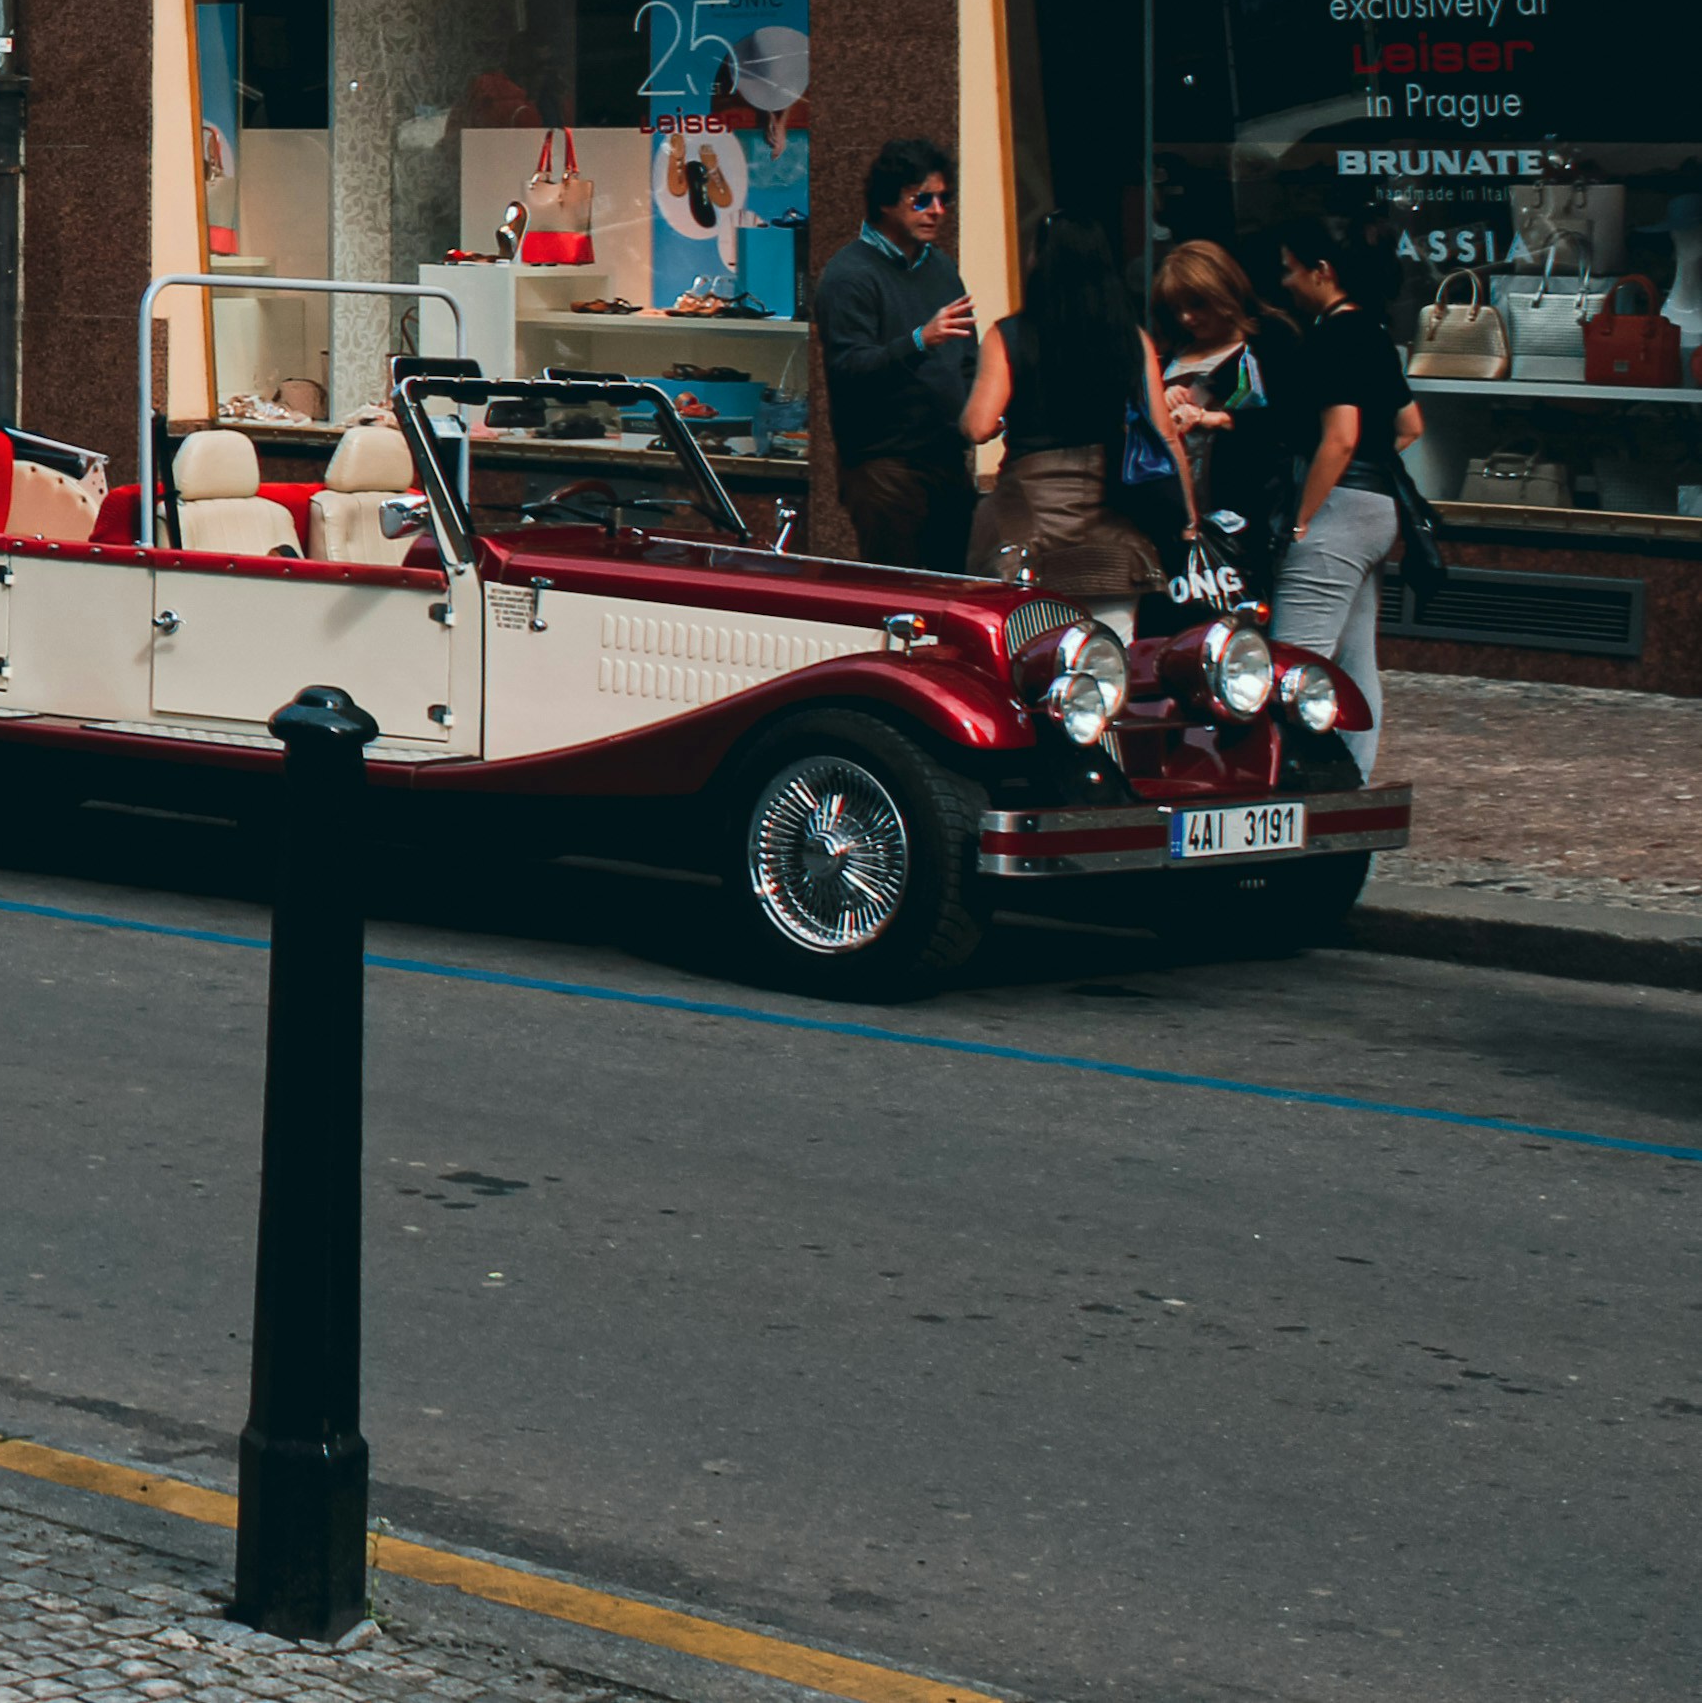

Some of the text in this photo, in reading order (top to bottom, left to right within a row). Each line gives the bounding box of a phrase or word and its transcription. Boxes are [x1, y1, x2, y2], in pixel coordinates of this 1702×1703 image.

[633, 0, 740, 97] 25
[1352, 31, 1535, 74] Leiser
[639, 106, 742, 135] Leiser
[1364, 83, 1522, 128] in Prague
[1336, 148, 1544, 176] BRUNATE
[1375, 185, 1454, 202] handmade
[1459, 185, 1475, 202] in
[1395, 228, 1535, 264] ASSIA
[1188, 806, 1295, 851] 4AI 3191
